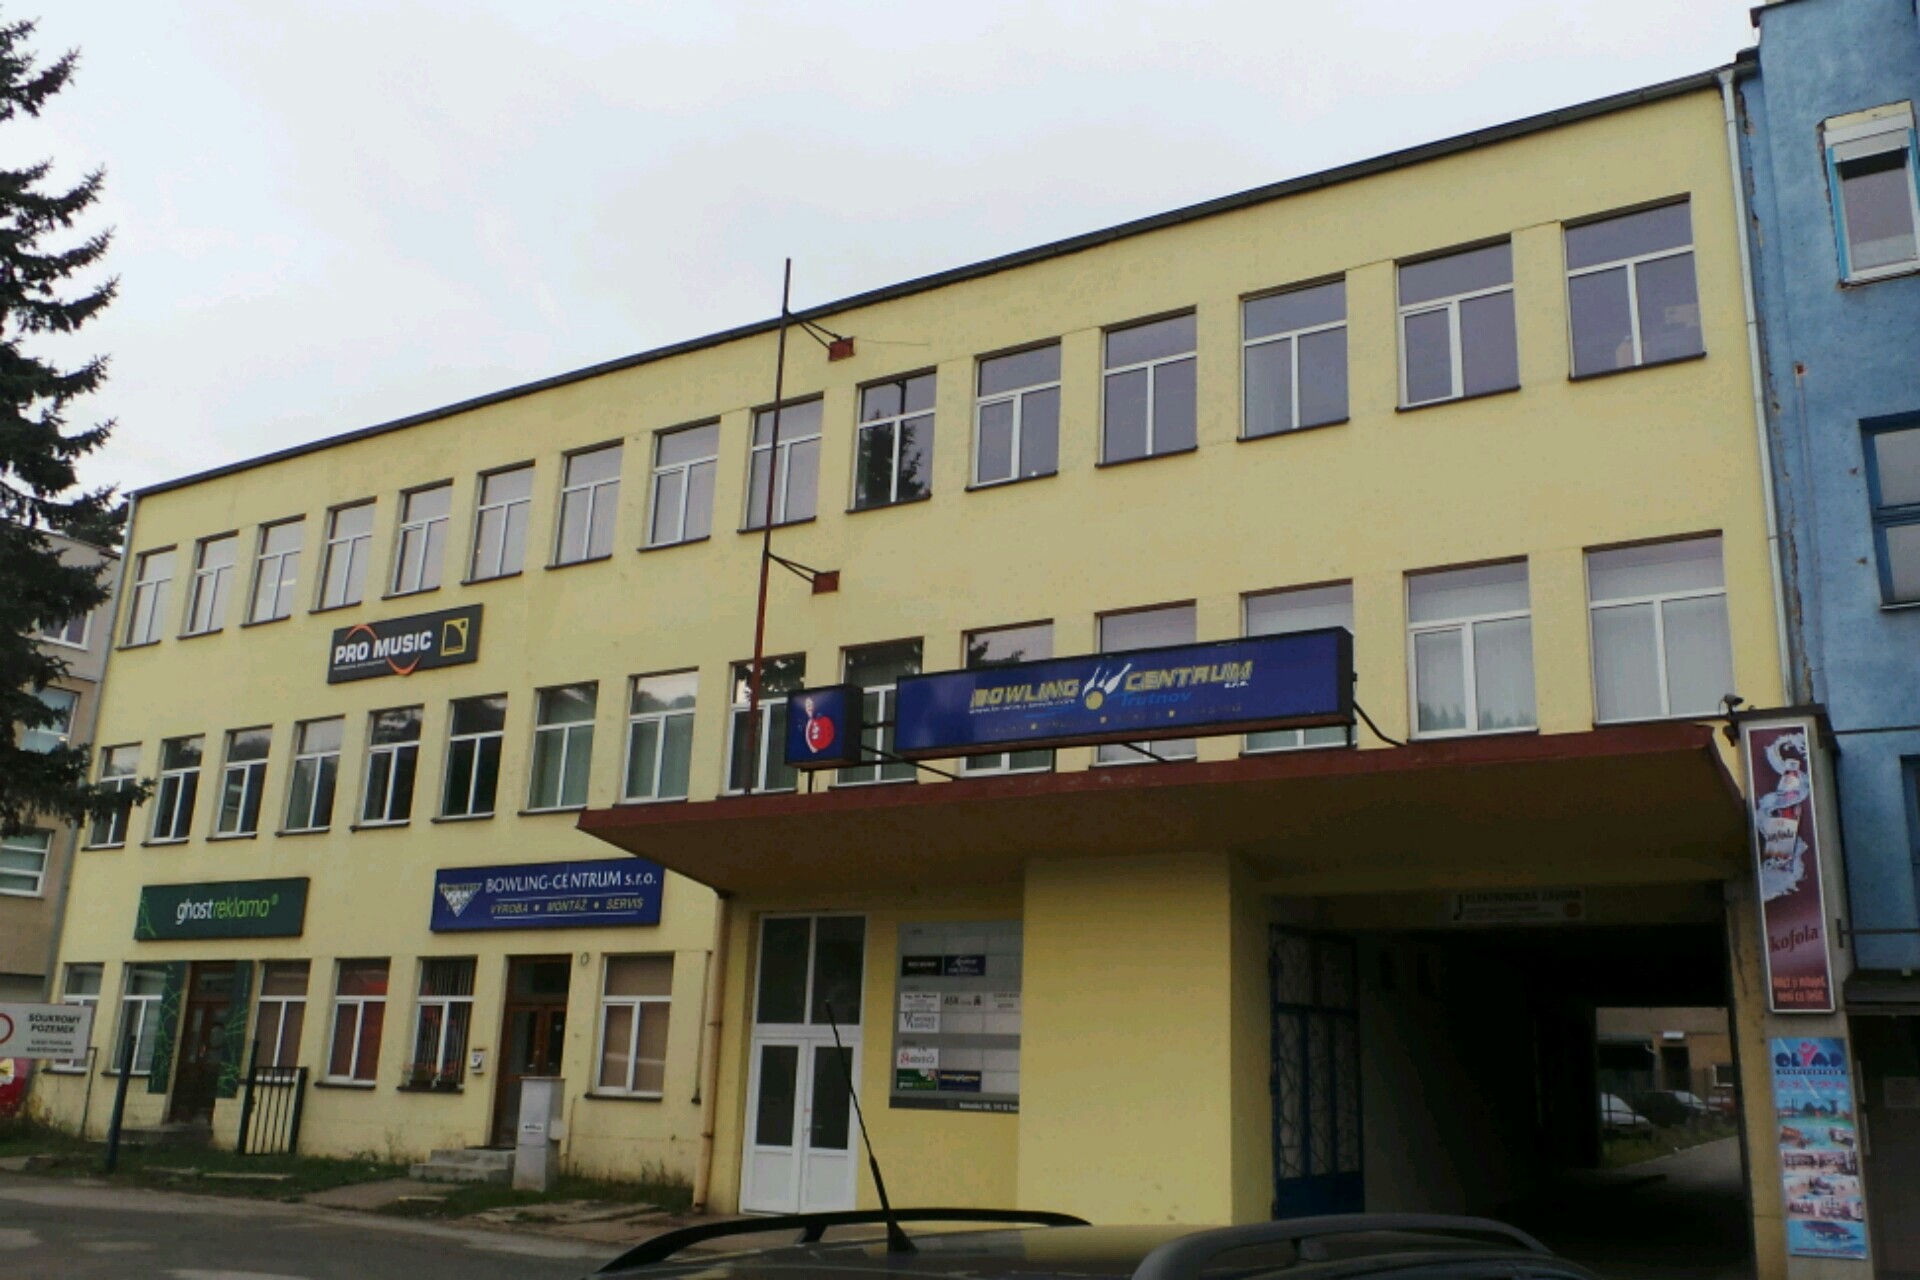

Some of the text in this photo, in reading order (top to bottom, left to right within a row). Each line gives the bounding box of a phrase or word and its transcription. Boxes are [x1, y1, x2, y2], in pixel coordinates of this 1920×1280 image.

[334, 630, 433, 664] PRO MUSIC
[970, 679, 1079, 708] BOWLING
[1124, 660, 1253, 691] CENTRUM
[1120, 691, 1192, 707] Trutnov
[485, 870, 657, 893] BOWLING-CENTRUM s.r.o.
[606, 896, 644, 910] SERVIS
[1769, 925, 1819, 953] kofola
[31, 1023, 76, 1034] POZEMEK
